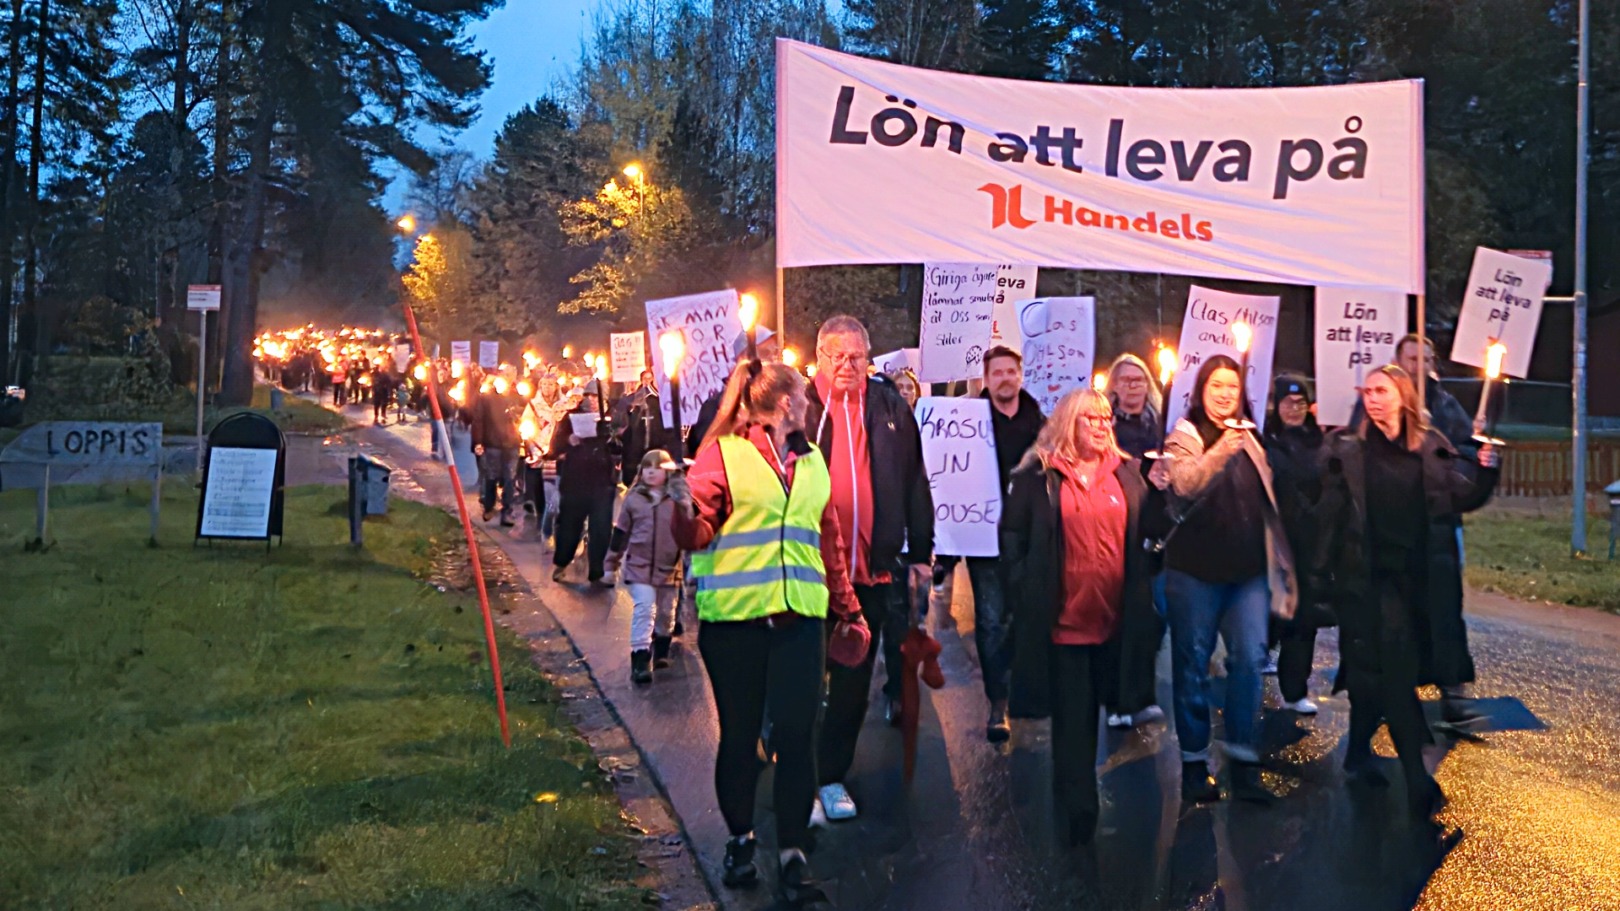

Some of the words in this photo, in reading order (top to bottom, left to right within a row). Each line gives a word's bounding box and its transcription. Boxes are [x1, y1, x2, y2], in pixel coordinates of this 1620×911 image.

[829, 85, 966, 154] Lön
[987, 126, 1083, 173] att
[1104, 118, 1252, 182] leva
[1272, 115, 1368, 200] på
[1044, 195, 1214, 242] Handels
[997, 277, 1026, 289] eva
[1494, 268, 1523, 287] Lön
[1475, 286, 1498, 300] att
[1499, 288, 1532, 309] leva
[685, 305, 729, 325] MAN
[1343, 302, 1378, 321] Lön
[1487, 306, 1511, 323] på
[1326, 327, 1352, 342] att
[1355, 325, 1394, 344] leva
[1348, 346, 1373, 369] på
[47, 430, 149, 455] LOPPIS
[935, 499, 999, 524] OUSE
